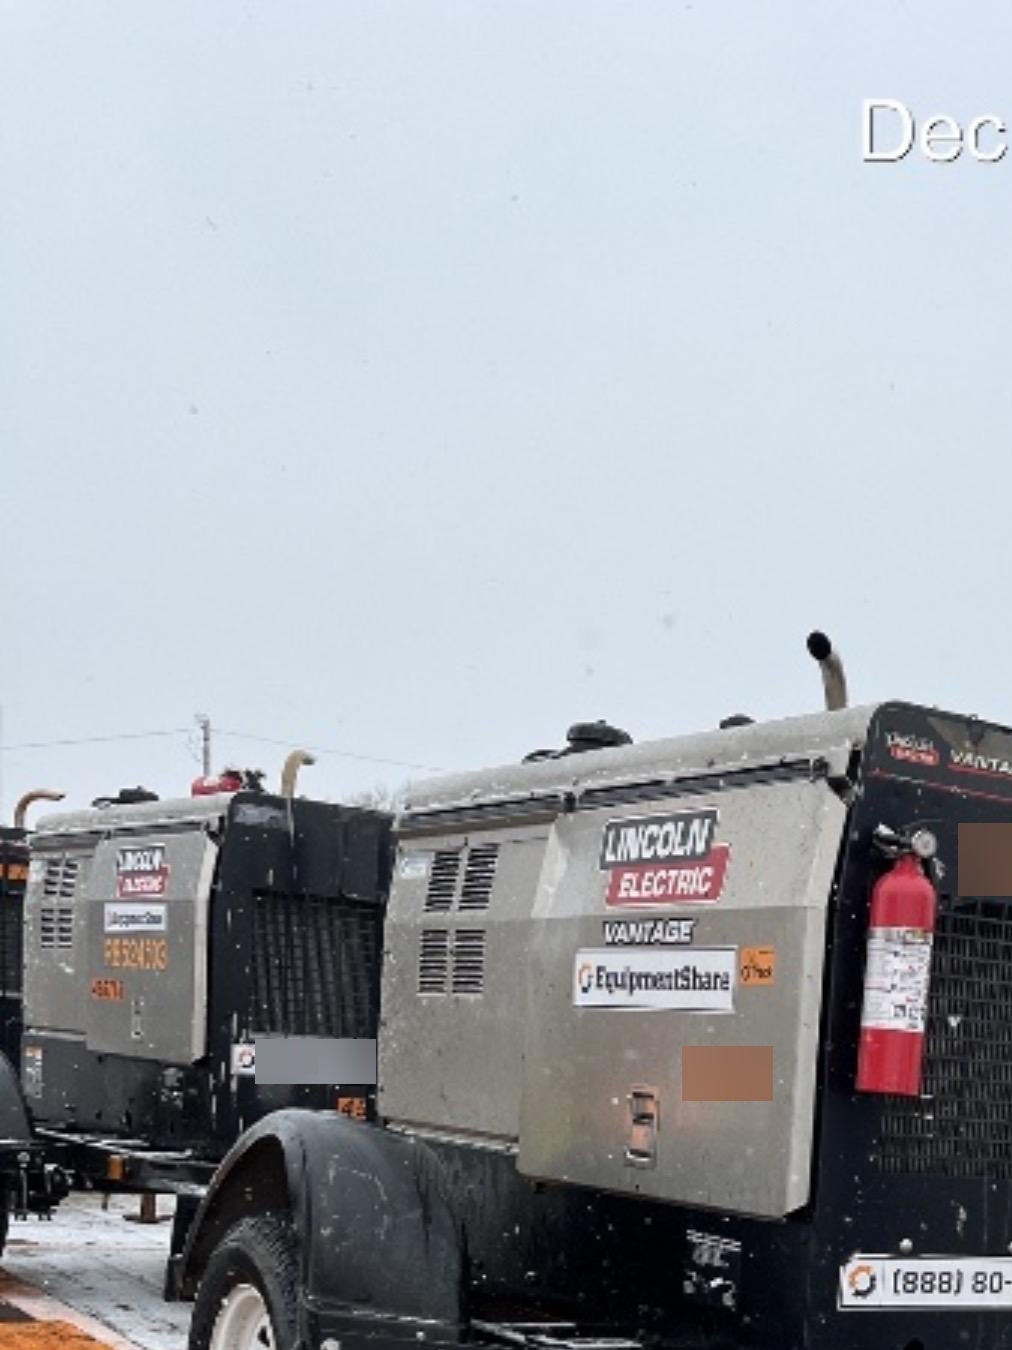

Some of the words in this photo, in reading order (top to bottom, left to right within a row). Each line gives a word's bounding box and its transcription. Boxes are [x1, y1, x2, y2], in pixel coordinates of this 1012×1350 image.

[605, 818, 710, 862] LINCOLN
[617, 866, 715, 899] ELECTRIC
[604, 919, 694, 944] VANTAGE
[595, 965, 731, 996] EquipmentShare
[893, 1269, 963, 1295] (888)
